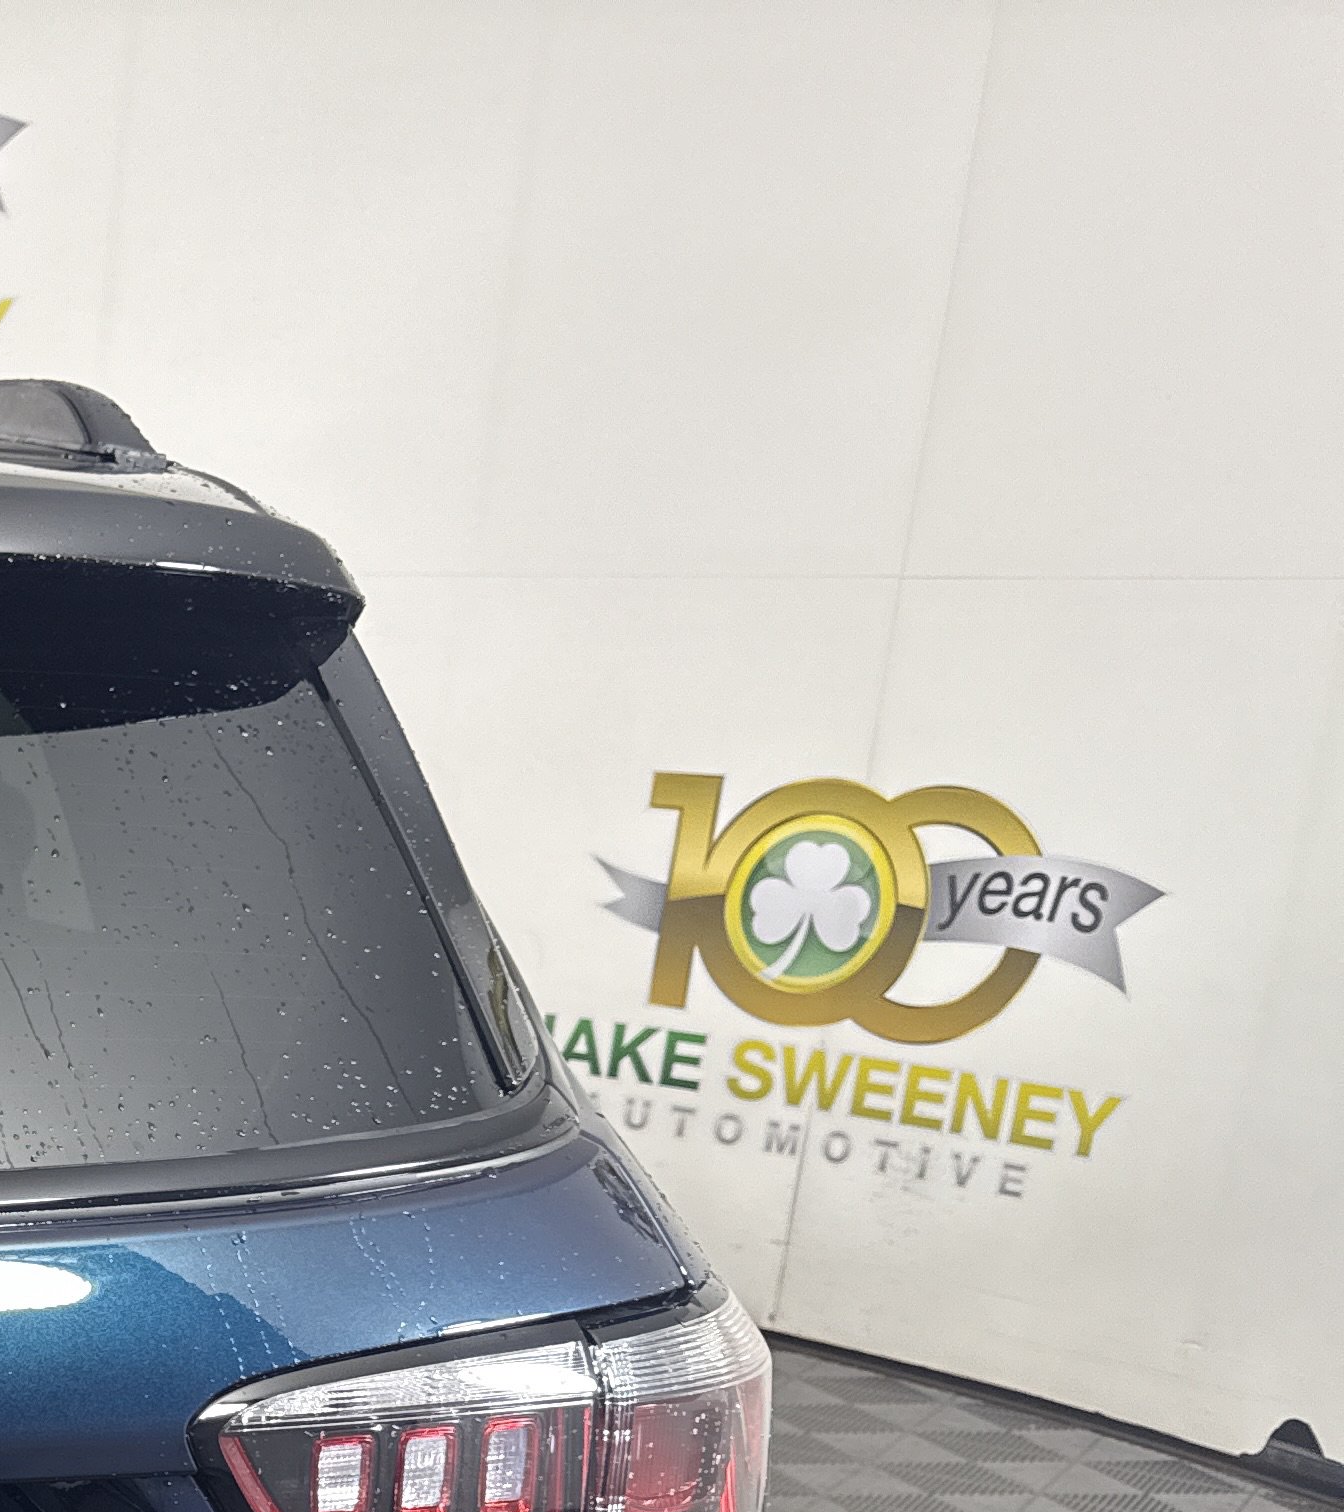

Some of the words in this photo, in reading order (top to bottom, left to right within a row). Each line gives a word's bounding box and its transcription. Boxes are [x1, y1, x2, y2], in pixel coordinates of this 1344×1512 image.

[648, 771, 1042, 1045] 100
[936, 868, 1109, 934] years
[543, 1014, 708, 1091] AKE
[725, 1039, 1123, 1158] SWEENEY
[586, 1092, 1030, 1199] UTOMOTIVE
